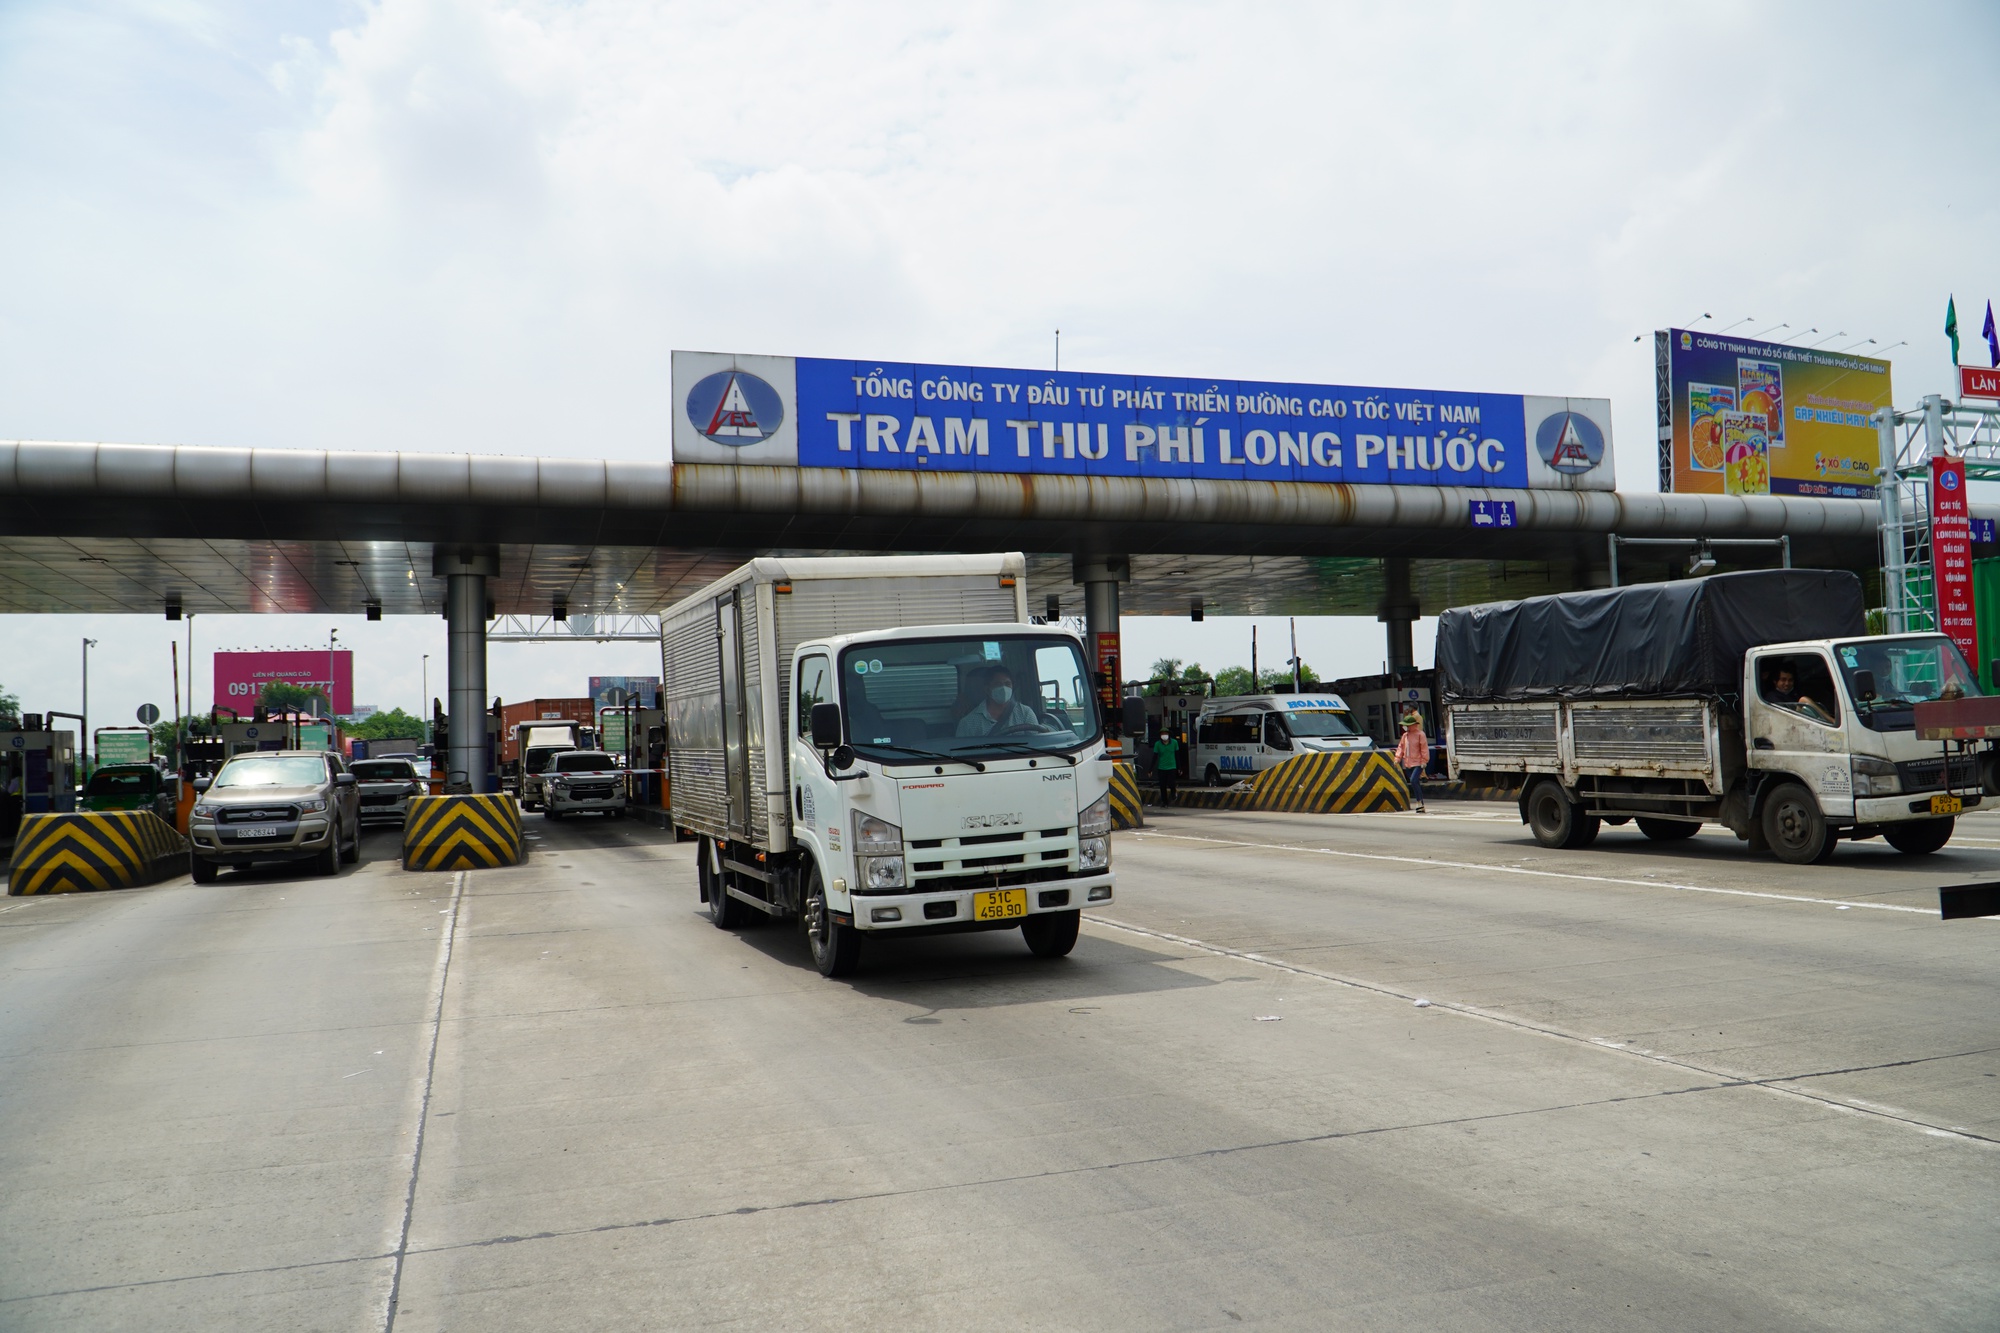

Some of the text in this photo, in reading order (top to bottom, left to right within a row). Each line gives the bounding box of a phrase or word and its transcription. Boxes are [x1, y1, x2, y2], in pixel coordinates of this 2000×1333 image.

[1696, 337, 1885, 374] CÔNG TY TNHH MTV XỔ SỐ KIẾN THIẾT THÀNH PHỐ HỒ CHÍ MINH
[1971, 374, 1996, 391] LÀN
[852, 368, 1481, 426] TỔNG CÔNG TY ĐẦU TƯ PHÁT TRIỂN ĐƯỜNG CAO TỐC VIỆT NAM
[1794, 405, 1814, 423] GẶP
[1815, 408, 1844, 425] NHIỀU
[1845, 412, 1866, 428] MAY
[826, 412, 1505, 473] TRẠM THU PHÍ LONG PHƯỚC
[1840, 457, 1851, 470] SỐ
[1286, 699, 1341, 709] HOA MAI
[1494, 728, 1533, 739] 60S 2437
[1220, 755, 1253, 770] HOA MAI
[1042, 773, 1072, 782] NMR
[1935, 803, 1958, 813] 2437
[960, 812, 1023, 829] ISUZU
[989, 891, 1011, 904] 51C
[981, 903, 1021, 918] 458.90
